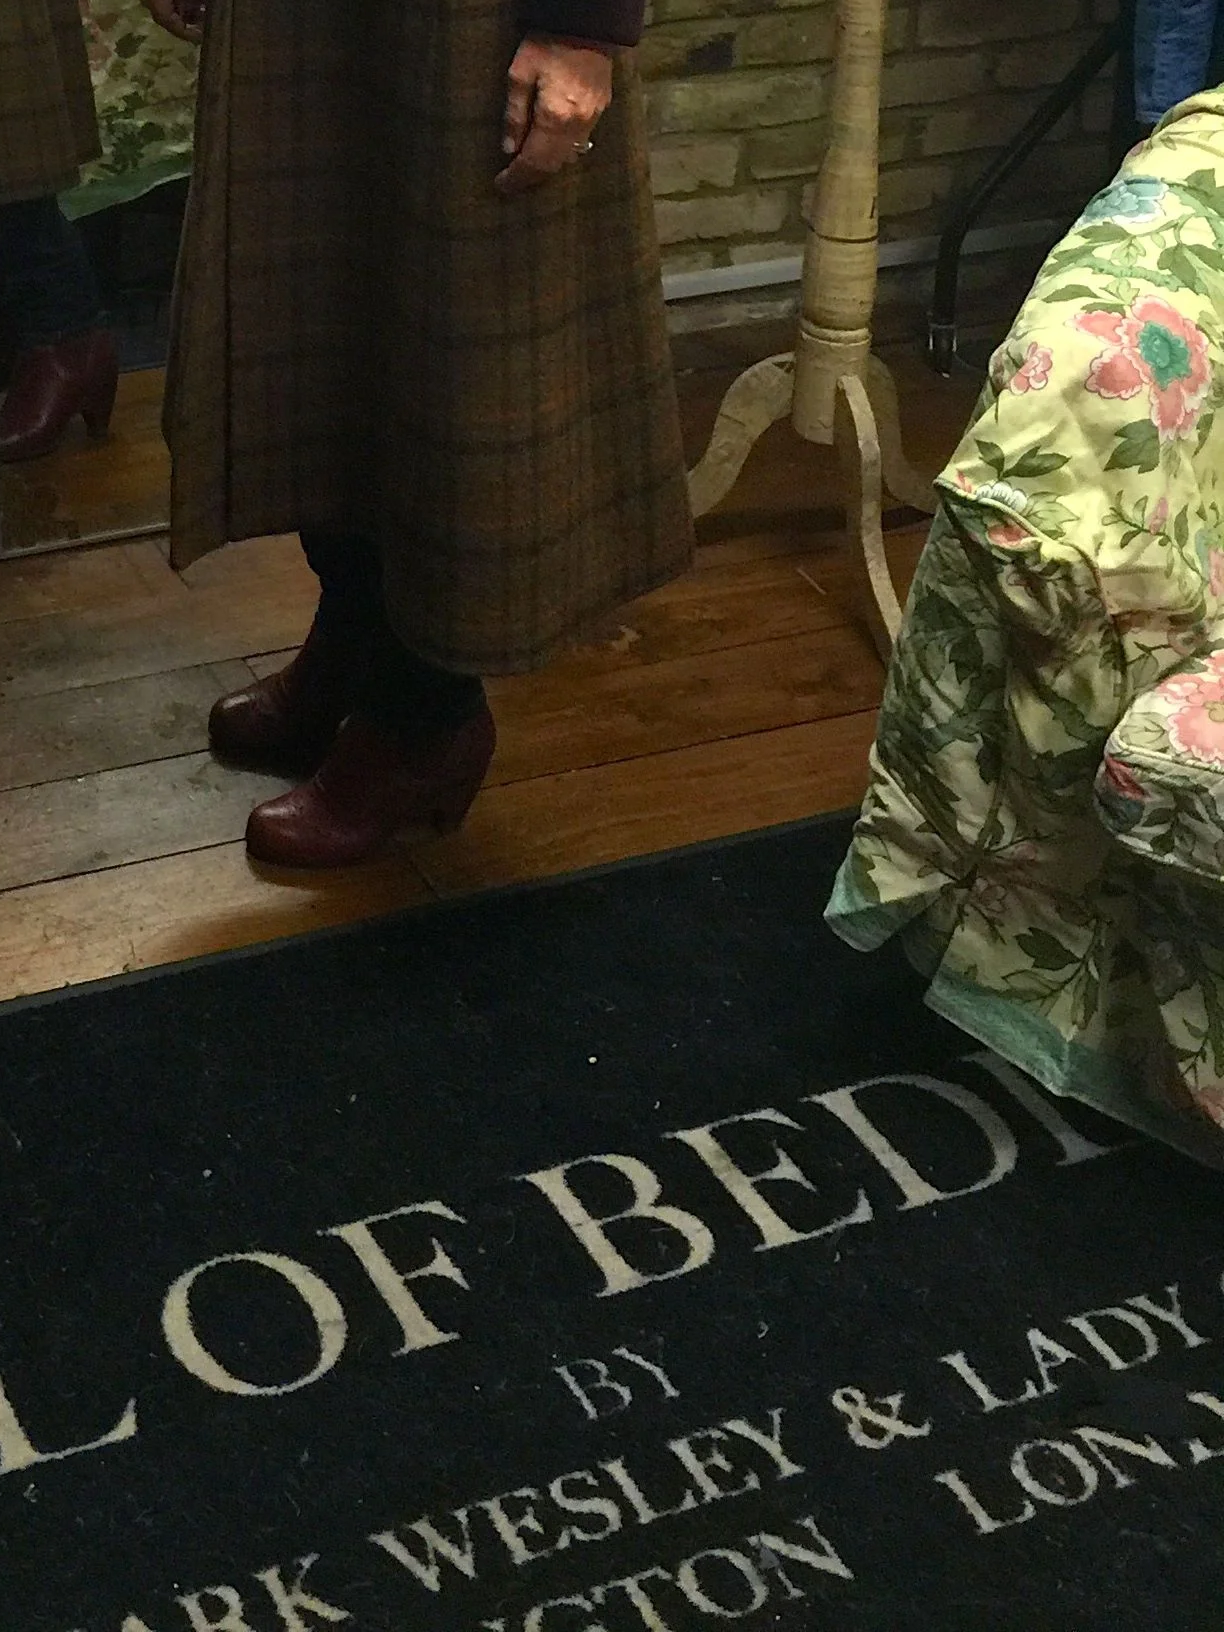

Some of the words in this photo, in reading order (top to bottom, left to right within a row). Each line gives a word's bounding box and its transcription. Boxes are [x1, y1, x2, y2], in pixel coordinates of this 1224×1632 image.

[159, 1200, 471, 1396] OF
[552, 1345, 684, 1421] BY
[370, 1406, 808, 1593] WESLEY
[832, 1385, 932, 1451] &
[939, 1282, 1213, 1414] LADY
